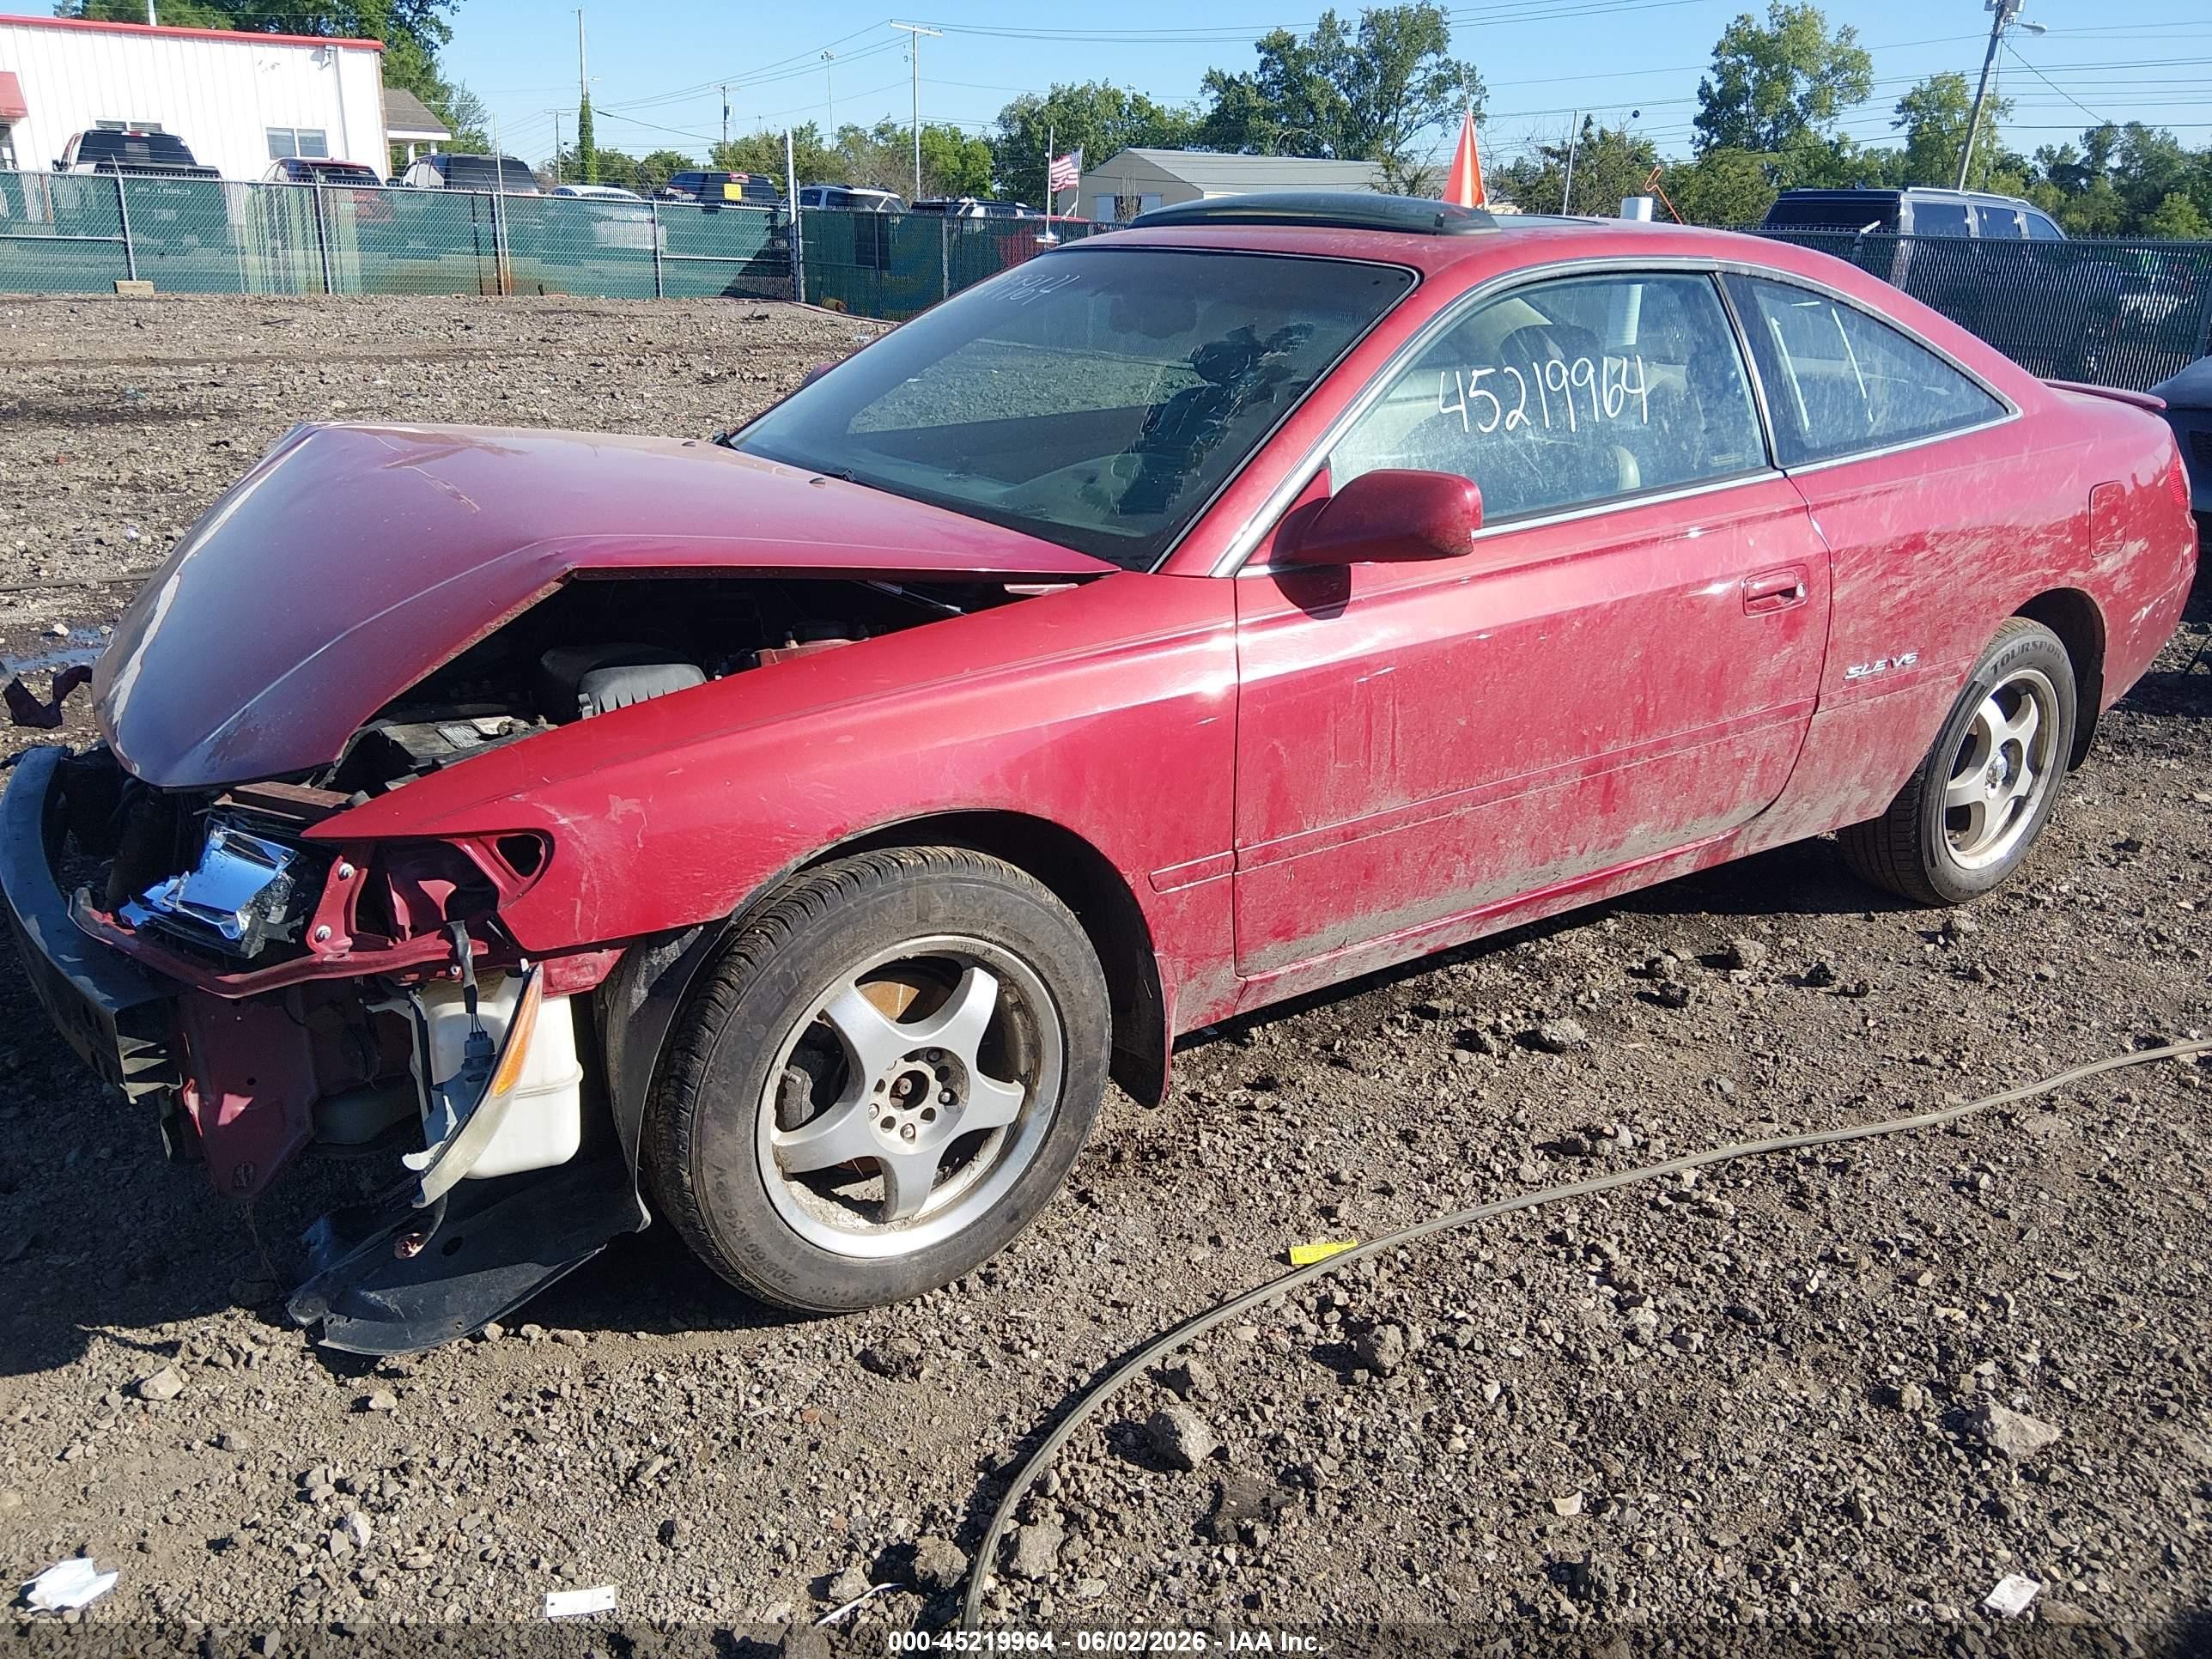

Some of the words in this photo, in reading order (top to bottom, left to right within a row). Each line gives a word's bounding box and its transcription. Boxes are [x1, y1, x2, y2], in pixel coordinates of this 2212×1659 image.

[1438, 354, 1649, 433] 45219964
[1844, 659, 1889, 680] SLE
[1892, 652, 1919, 668] V6
